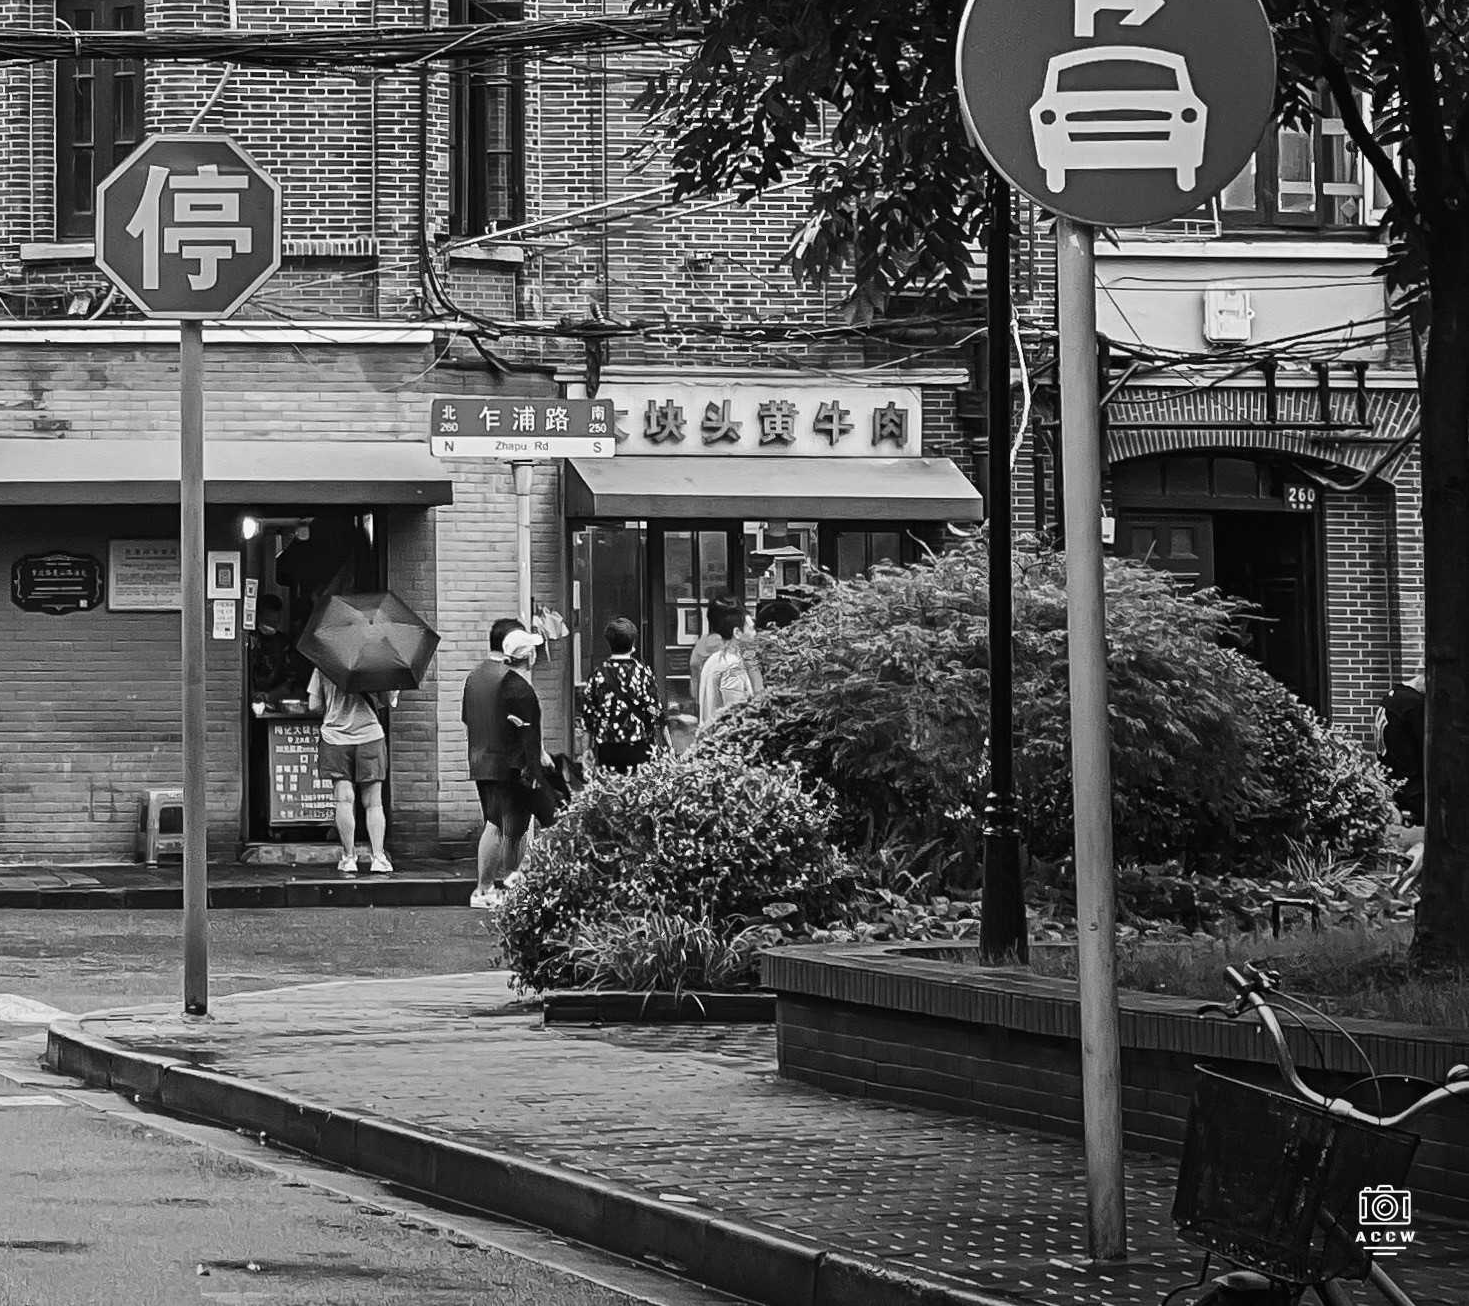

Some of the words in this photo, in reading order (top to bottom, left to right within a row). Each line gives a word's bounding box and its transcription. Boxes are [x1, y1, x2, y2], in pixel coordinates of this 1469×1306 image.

[125, 163, 252, 290] 停
[441, 405, 456, 420] 北
[479, 405, 570, 432] 乍浦路
[591, 405, 605, 421] 南
[439, 422, 459, 433] 260
[588, 423, 607, 434] 250
[444, 440, 454, 452] N
[495, 441, 528, 454] Zhapu
[534, 441, 549, 451] Rd
[593, 442, 603, 453] S
[1289, 487, 1315, 502] 260
